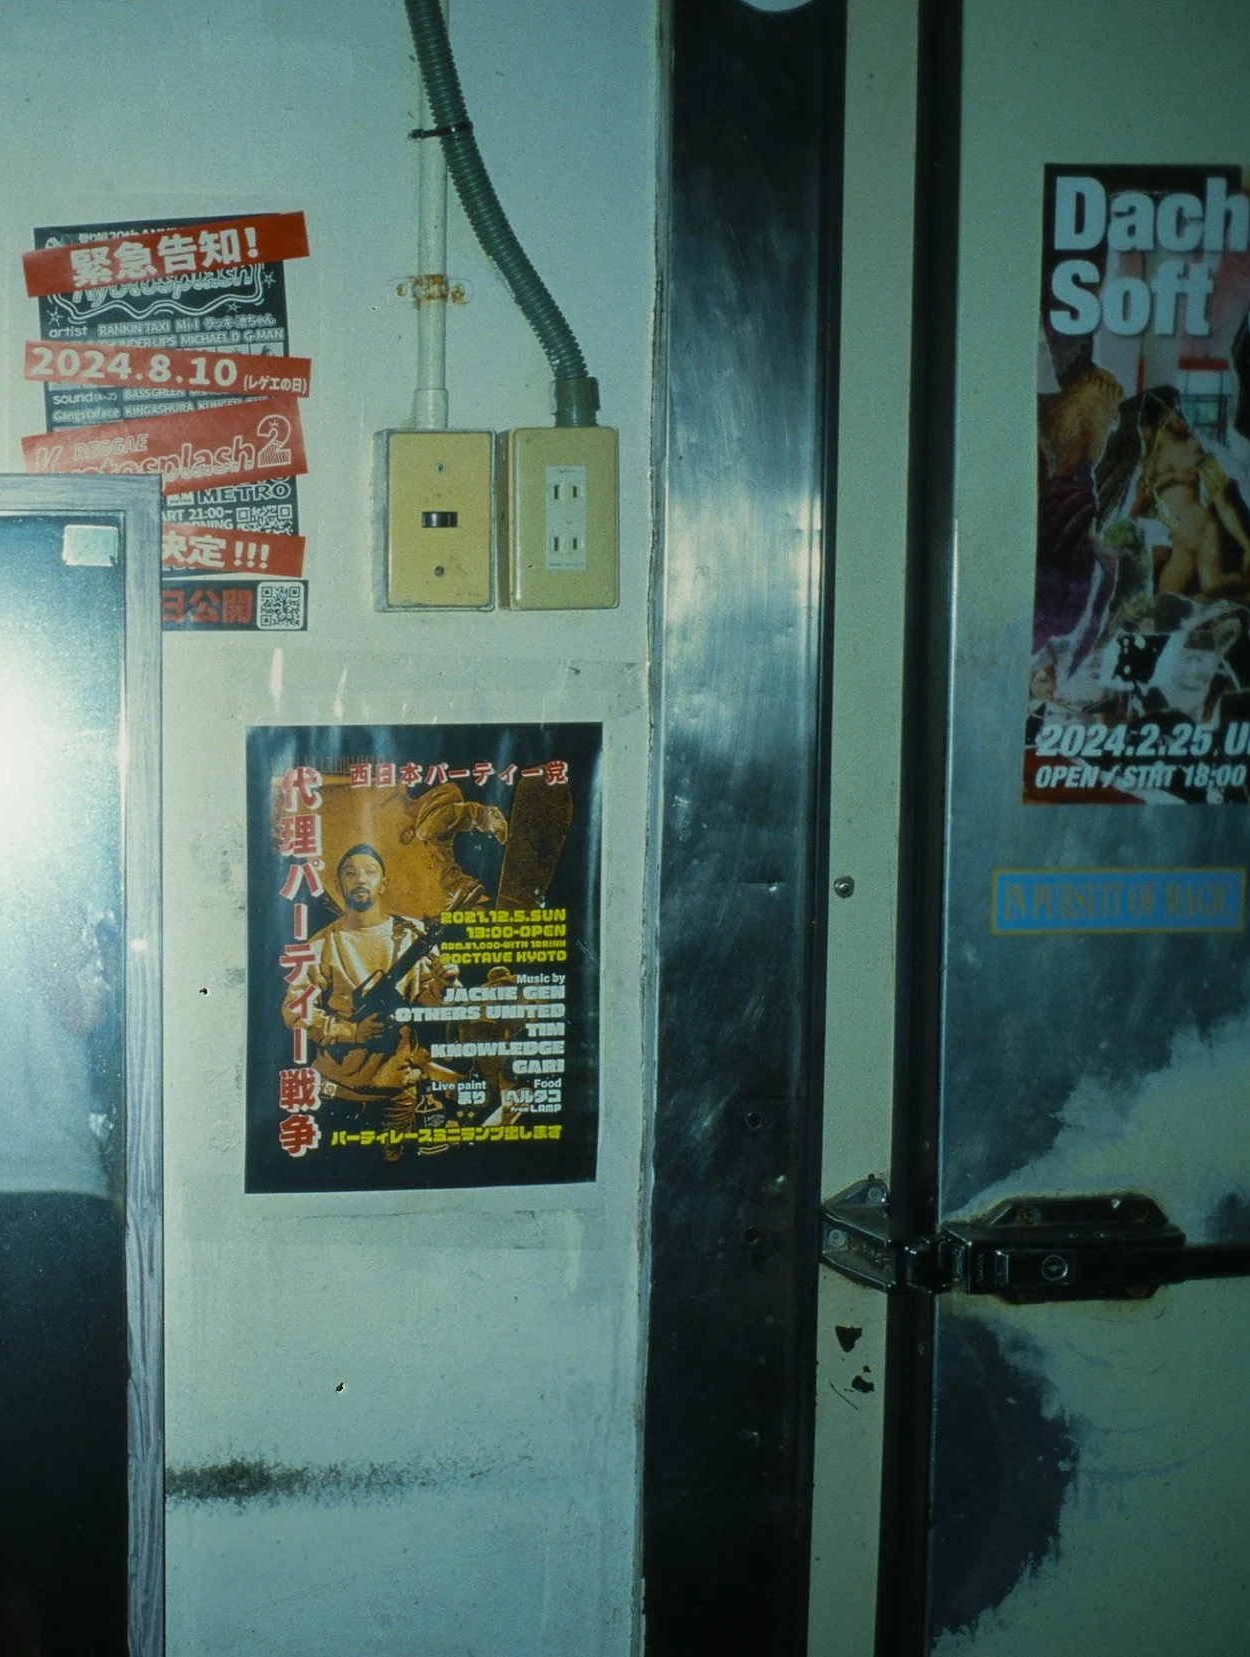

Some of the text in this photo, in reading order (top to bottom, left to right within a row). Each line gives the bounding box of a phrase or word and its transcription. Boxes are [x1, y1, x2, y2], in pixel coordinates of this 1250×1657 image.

[70, 227, 260, 288] 緊急告知!
[1049, 258, 1215, 336] Soft
[49, 325, 89, 337] artist
[30, 346, 238, 387] 2024.8.10
[198, 481, 292, 505] METRO
[1034, 721, 1250, 757] 2024.2.25 U
[1035, 764, 1100, 789] OPEN
[1181, 763, 1247, 788] 18:00
[278, 766, 326, 1157] 代理パーティー戦争
[516, 973, 567, 985] Music by
[443, 985, 566, 1002] JACKIE GEN
[395, 1004, 566, 1022] OTHERS UNITED
[525, 1022, 565, 1037] TIM
[430, 1040, 566, 1058] KNOWLEDGE
[512, 1059, 565, 1074] GARI
[431, 1080, 487, 1092] Live paint
[534, 1078, 562, 1089] Food
